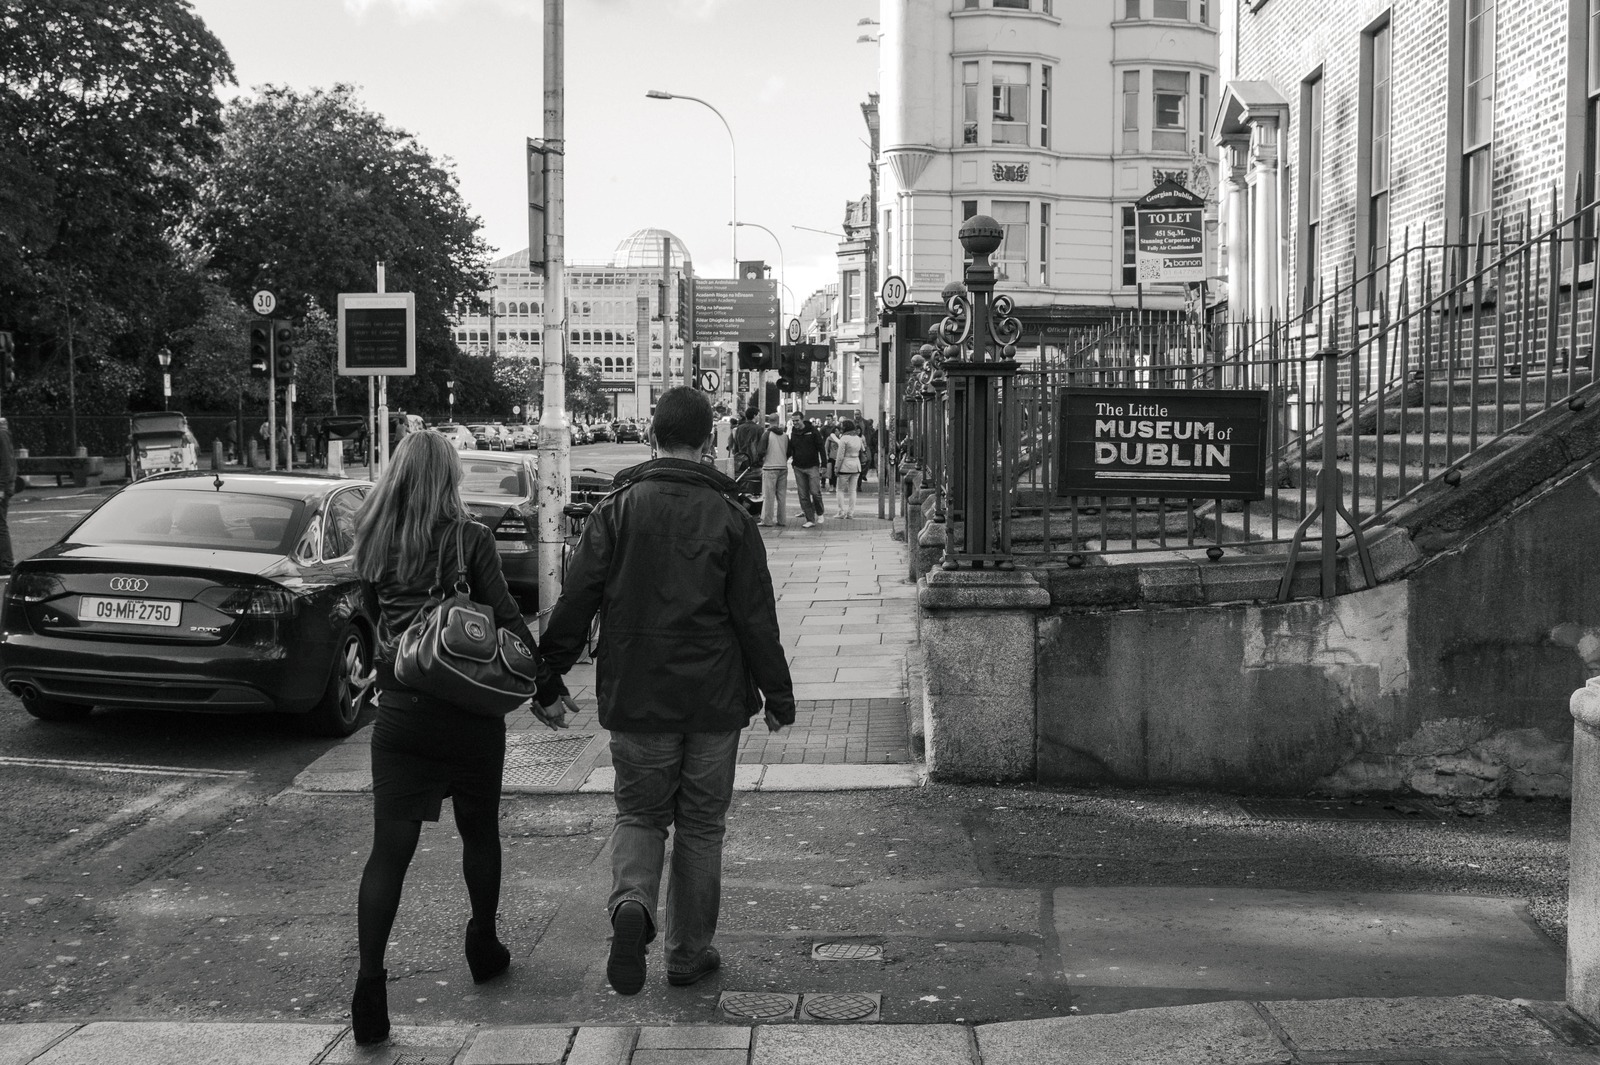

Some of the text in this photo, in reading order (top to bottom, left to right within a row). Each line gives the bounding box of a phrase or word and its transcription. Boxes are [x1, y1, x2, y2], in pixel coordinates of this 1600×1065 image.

[1146, 190, 1193, 202] Georgian Dublin
[1148, 213, 1192, 224] TO LET
[888, 284, 901, 299] 30
[258, 295, 271, 307] 30
[791, 324, 798, 334] 30
[1096, 402, 1168, 417] The Little
[1095, 420, 1233, 440] MUSEUM of
[1095, 442, 1230, 467] DUBLIN
